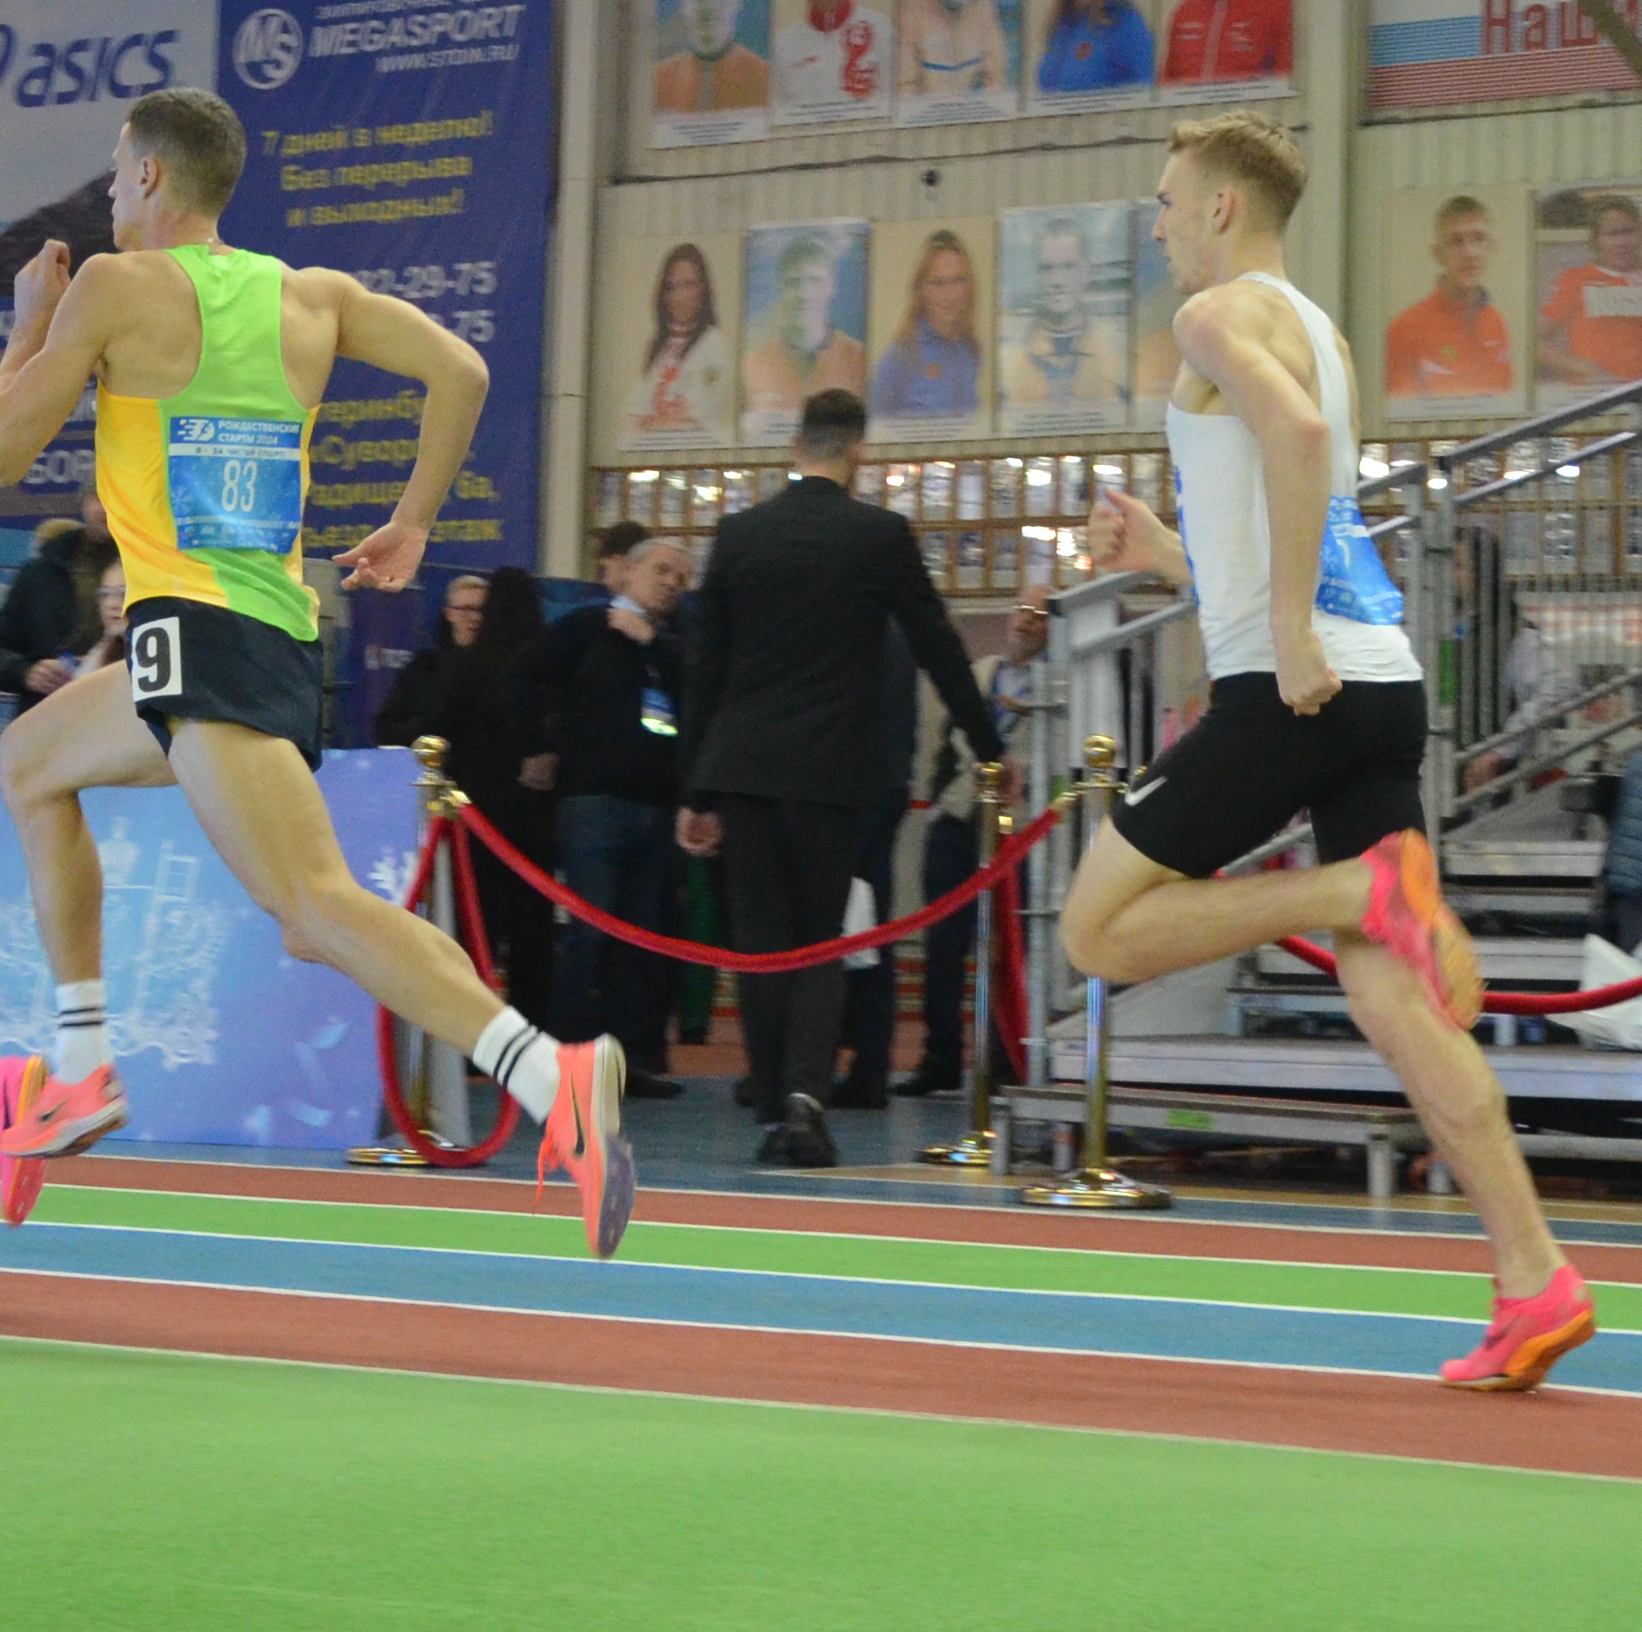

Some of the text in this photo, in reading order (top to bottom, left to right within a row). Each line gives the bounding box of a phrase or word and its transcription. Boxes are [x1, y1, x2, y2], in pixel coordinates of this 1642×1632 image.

[308, 3, 527, 58] MEGASPORT
[15, 29, 180, 108] asics
[261, 130, 280, 156] 7
[281, 124, 348, 158] дней
[280, 164, 331, 192] Без
[221, 459, 257, 512] 83
[134, 625, 172, 694] 9
